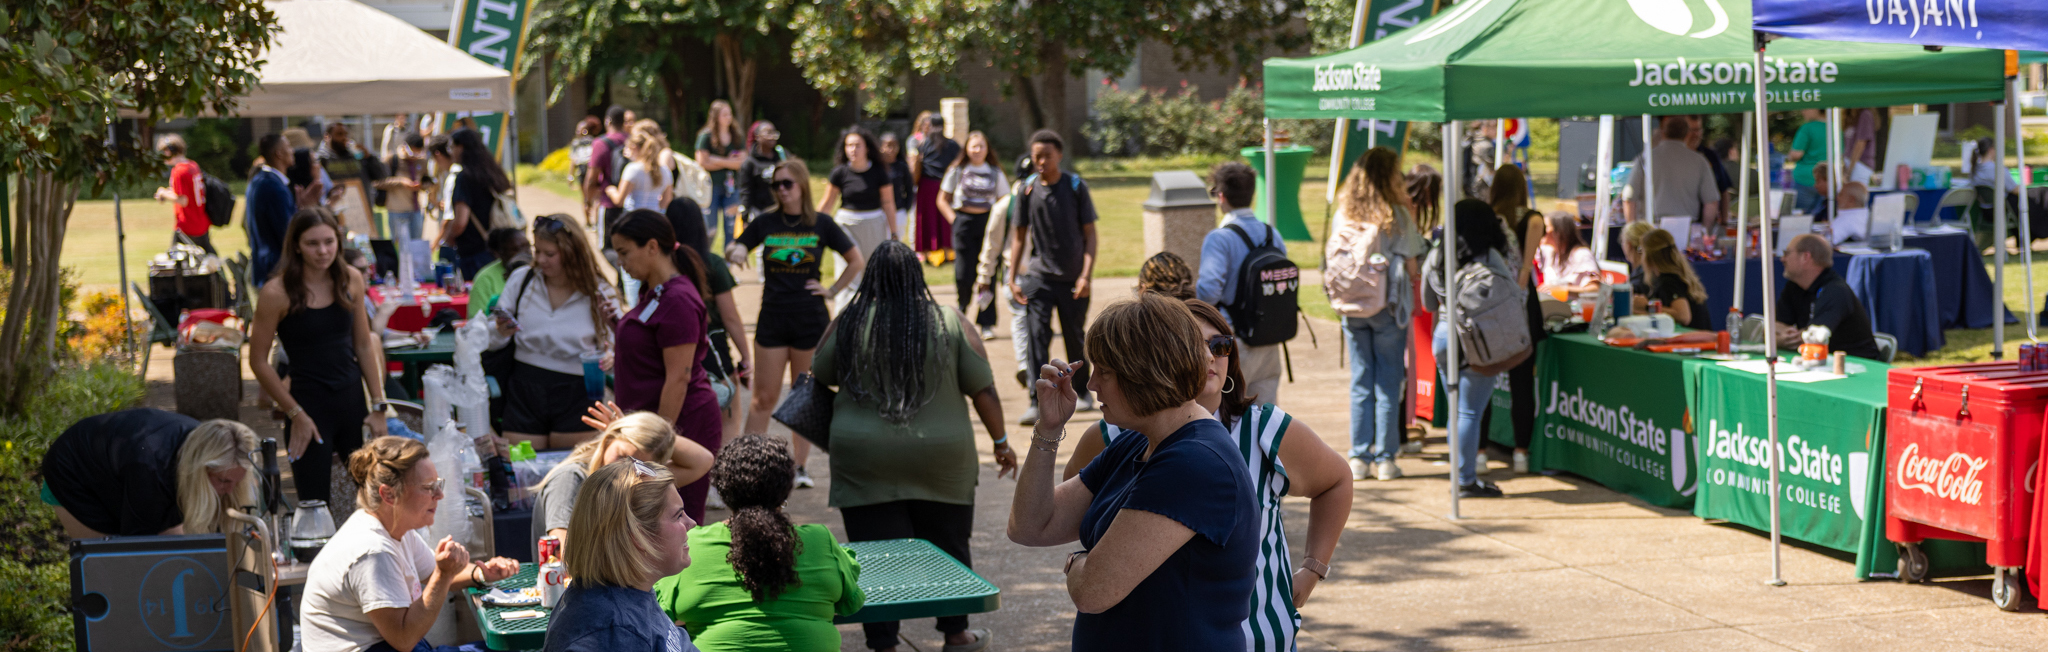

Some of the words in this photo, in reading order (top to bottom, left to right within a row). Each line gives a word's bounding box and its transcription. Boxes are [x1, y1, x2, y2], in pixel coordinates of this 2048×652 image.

[1312, 62, 1353, 91] Jackson
[1354, 62, 1381, 91] State
[1629, 57, 1753, 87] Jackson
[1763, 56, 1839, 84] State
[1648, 91, 1747, 107] COMMUNITY
[1753, 89, 1822, 104] OLLEGE
[1546, 380, 1618, 437] Jackson
[1619, 405, 1667, 456] State
[1544, 422, 1615, 461] COMMUNITY
[1616, 449, 1666, 481] COLLEGE
[1787, 434, 1843, 486] State
[1896, 442, 1989, 506] Coca-Cola
[1786, 484, 1842, 515] COLLEGE
